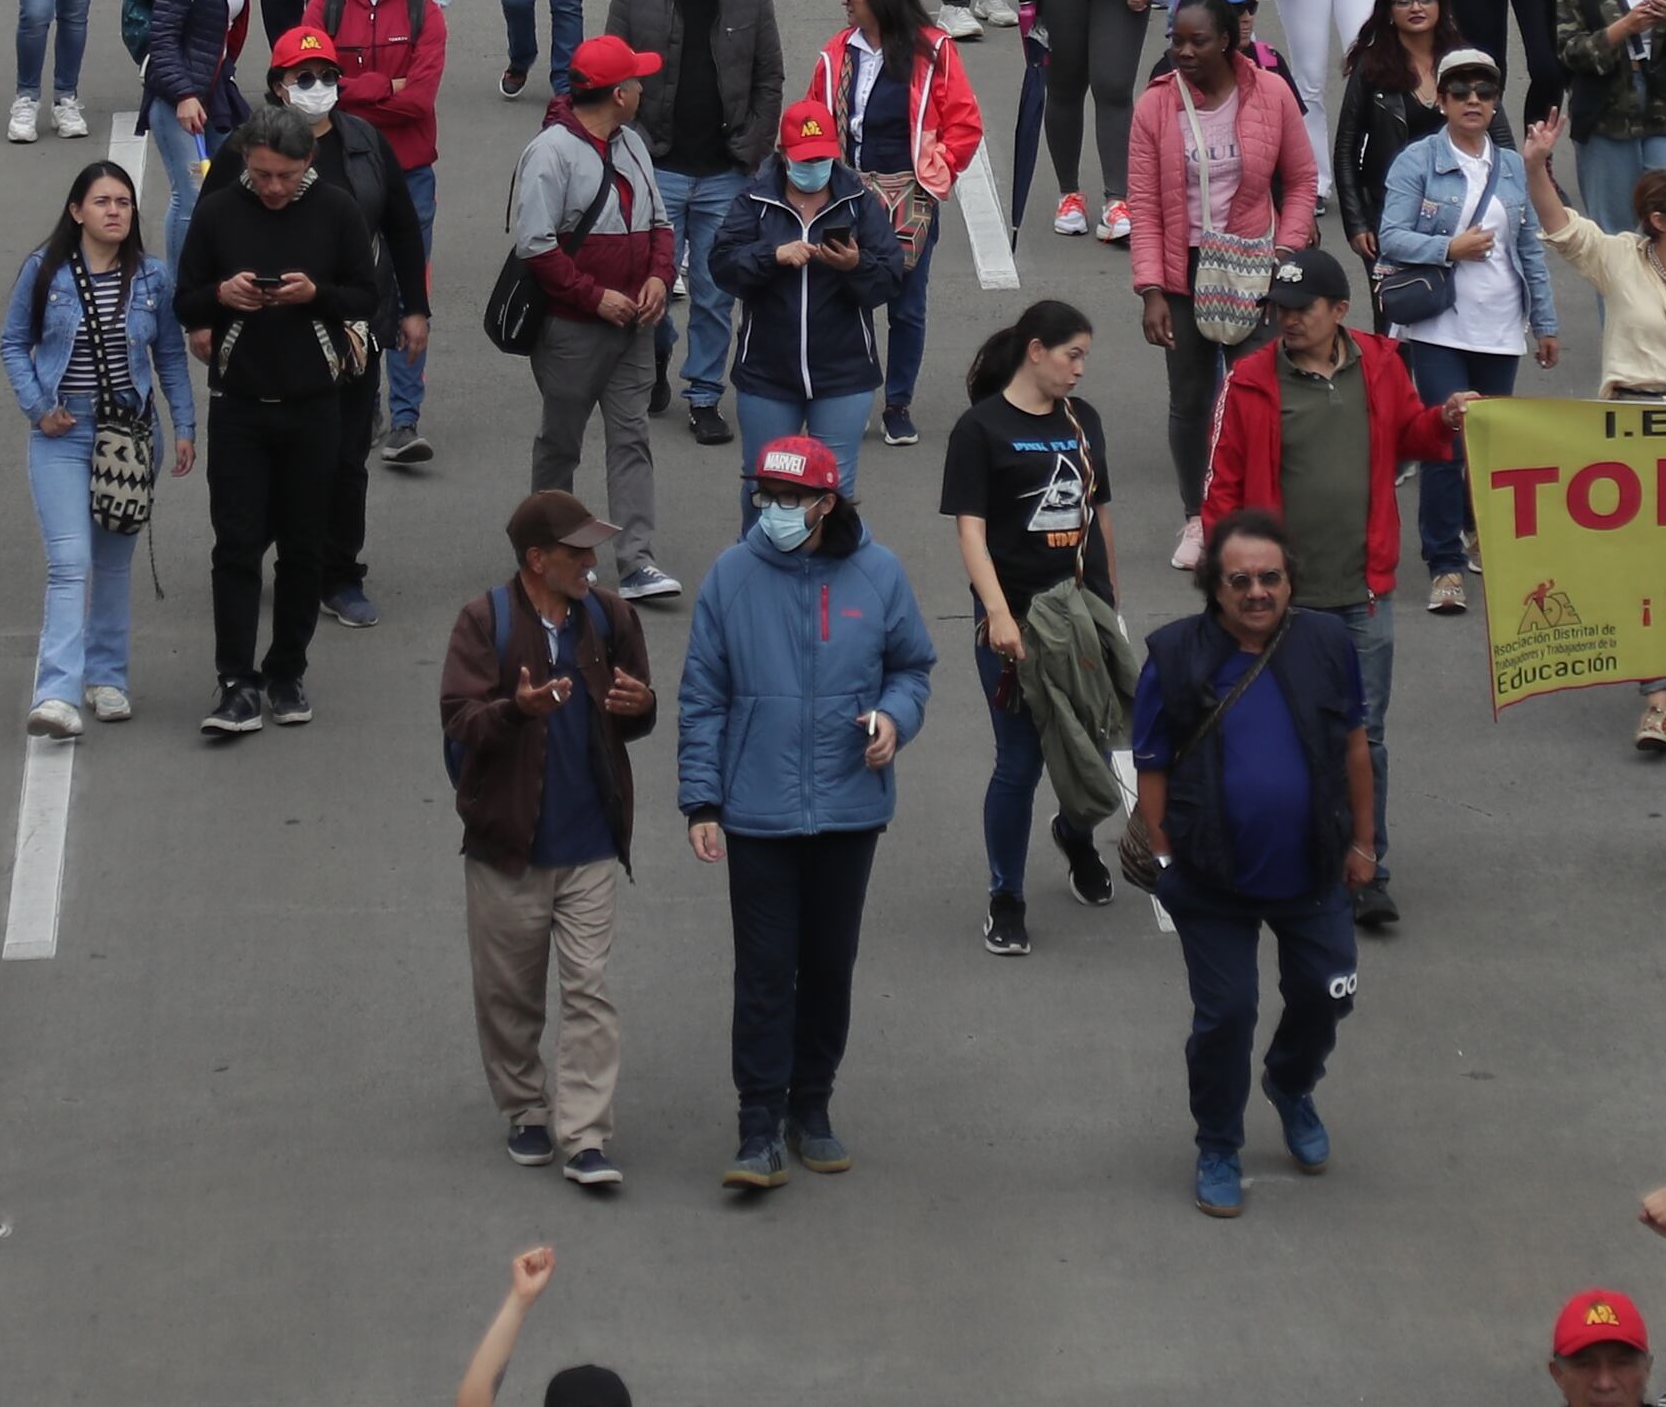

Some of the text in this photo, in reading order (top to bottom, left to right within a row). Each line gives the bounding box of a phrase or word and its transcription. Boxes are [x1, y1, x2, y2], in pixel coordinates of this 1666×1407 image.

[765, 453, 806, 476] MARVEL
[1600, 624, 1616, 636] de
[1496, 652, 1618, 695] Educación
